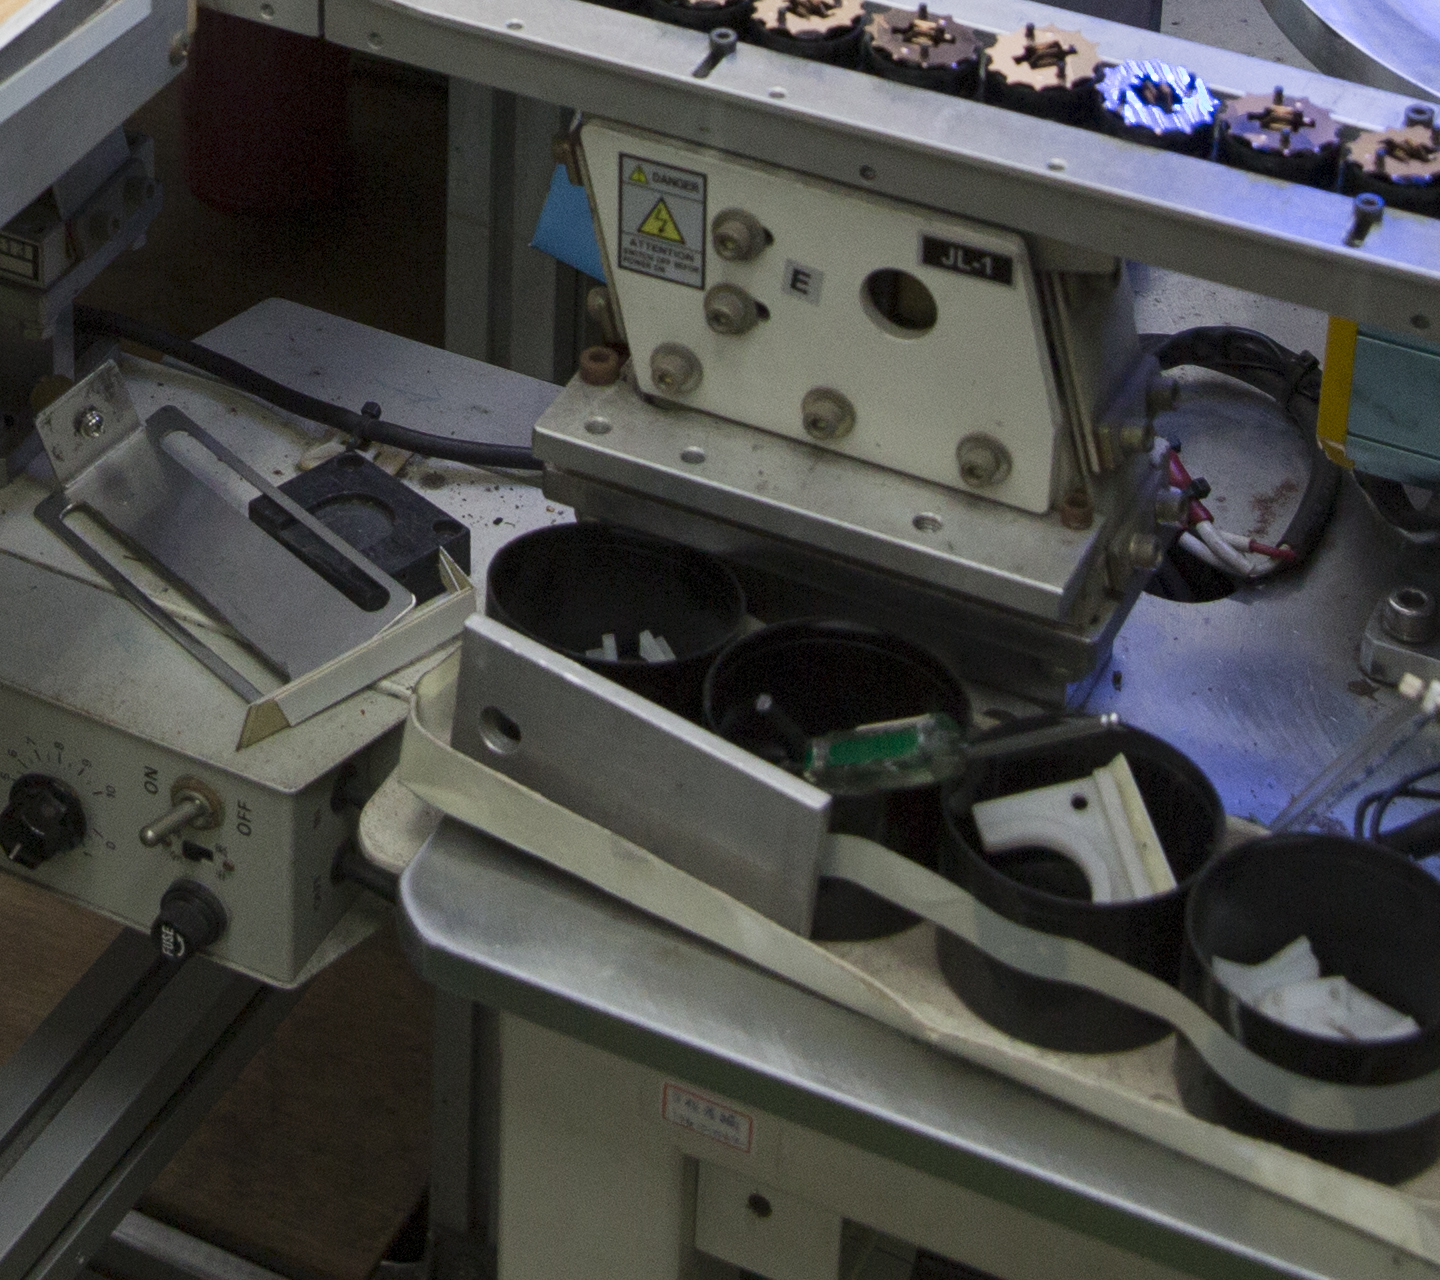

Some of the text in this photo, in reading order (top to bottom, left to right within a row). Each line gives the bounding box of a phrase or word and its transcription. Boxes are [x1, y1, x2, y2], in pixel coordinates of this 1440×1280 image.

[941, 248, 993, 276] JL-1
[790, 268, 811, 295] E
[143, 764, 159, 796] ON
[235, 798, 252, 837] OFF
[161, 924, 175, 957] FUSE
